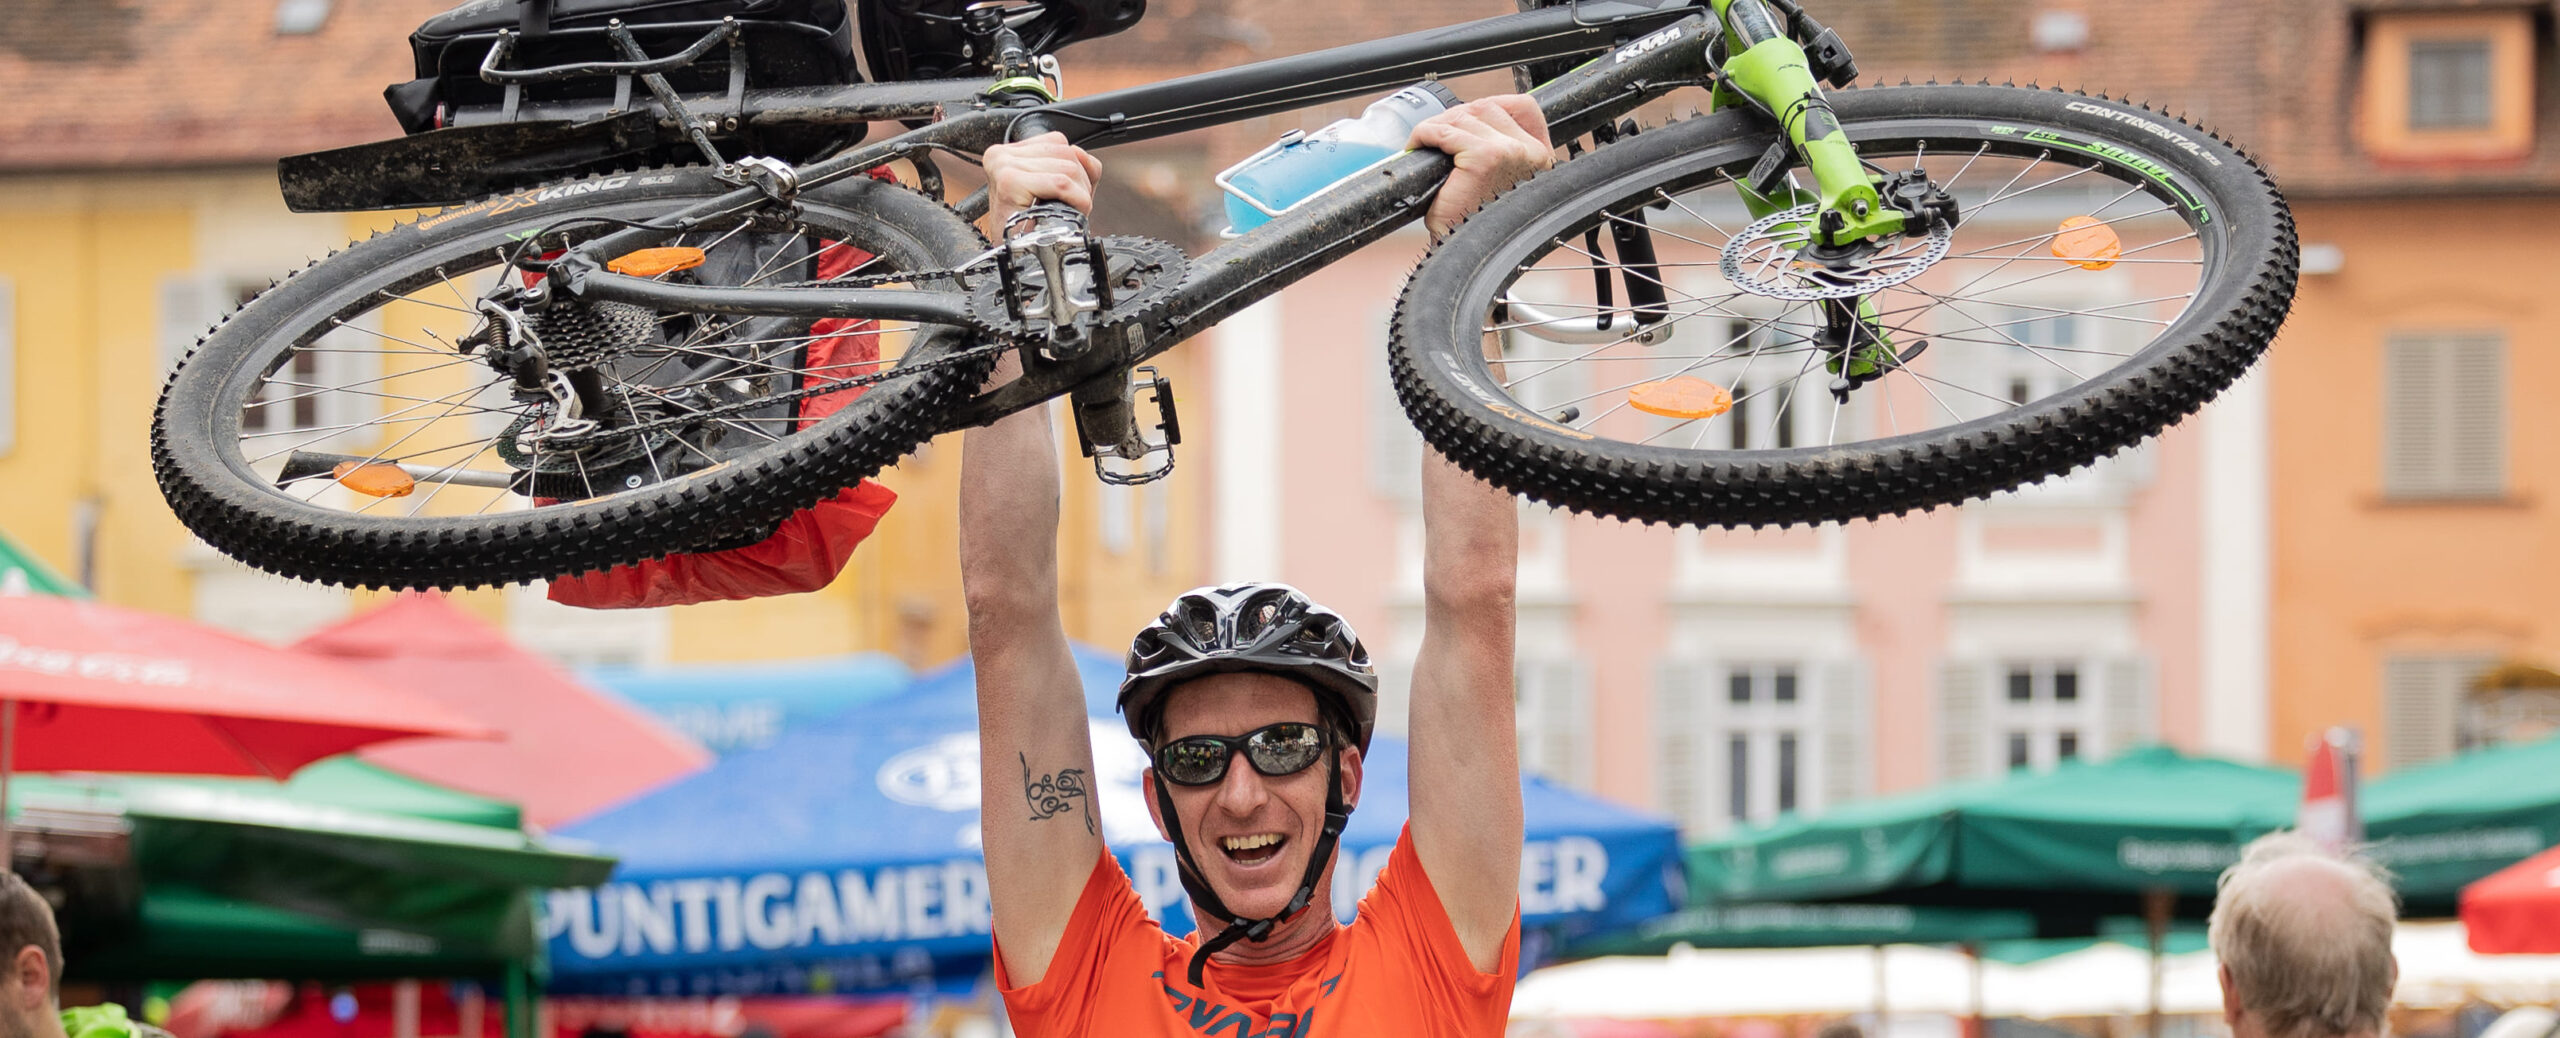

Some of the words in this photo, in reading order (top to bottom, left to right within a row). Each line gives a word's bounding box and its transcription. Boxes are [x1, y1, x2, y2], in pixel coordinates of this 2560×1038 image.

[1615, 26, 1682, 64] KTM
[2066, 101, 2201, 156] CONTINENTAL
[2086, 140, 2175, 181] TAURUS
[541, 857, 992, 959] PUNTIGAMER
